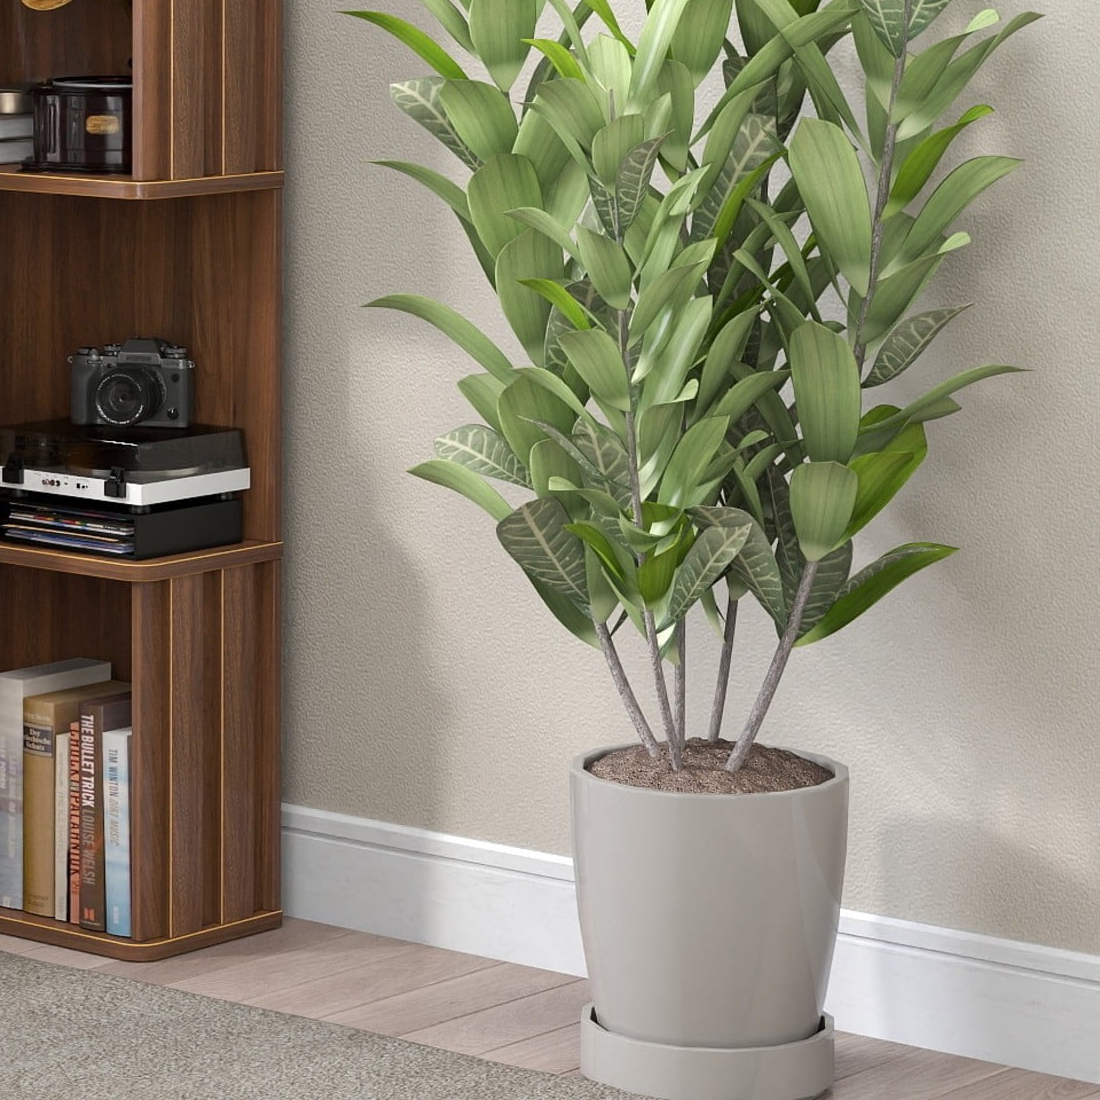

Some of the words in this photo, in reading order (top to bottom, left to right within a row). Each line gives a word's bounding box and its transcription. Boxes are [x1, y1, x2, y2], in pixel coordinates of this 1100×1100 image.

[81, 714, 94, 734] THE
[81, 735, 94, 775] BULLET
[108, 748, 119, 764] TIM
[81, 776, 95, 807] TRICK
[108, 766, 119, 797] WINTON
[82, 809, 95, 847] LOUISE
[82, 849, 95, 885] WELSH
